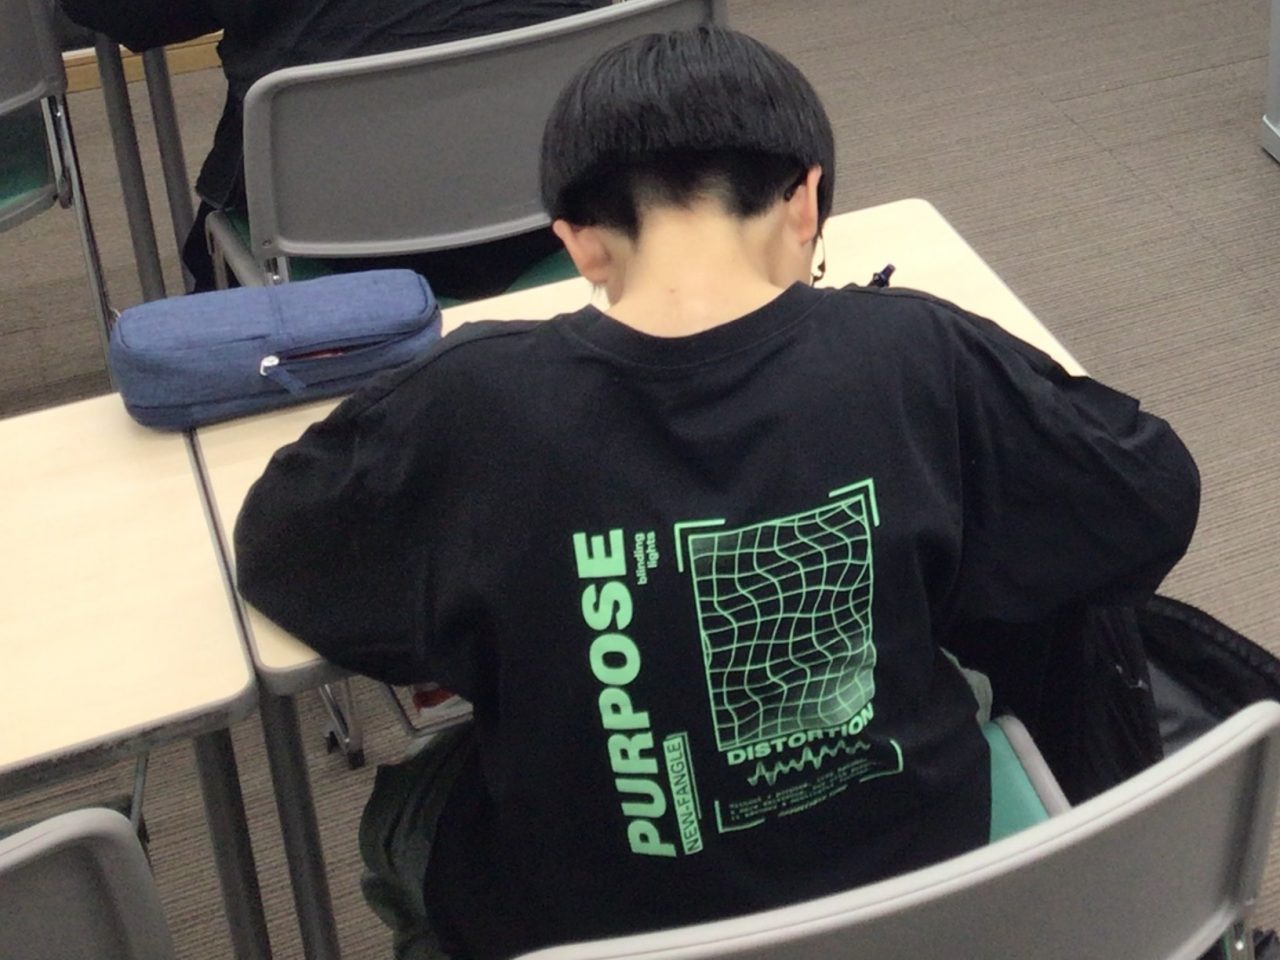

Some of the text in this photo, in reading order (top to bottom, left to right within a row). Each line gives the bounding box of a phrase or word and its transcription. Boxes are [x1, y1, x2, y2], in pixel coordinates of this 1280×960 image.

[634, 532, 648, 585] blinding
[645, 531, 659, 568] lights
[573, 528, 677, 858] PURPOSE
[726, 701, 875, 766] DISTORTION
[666, 741, 700, 852] NEW-FANGLE
